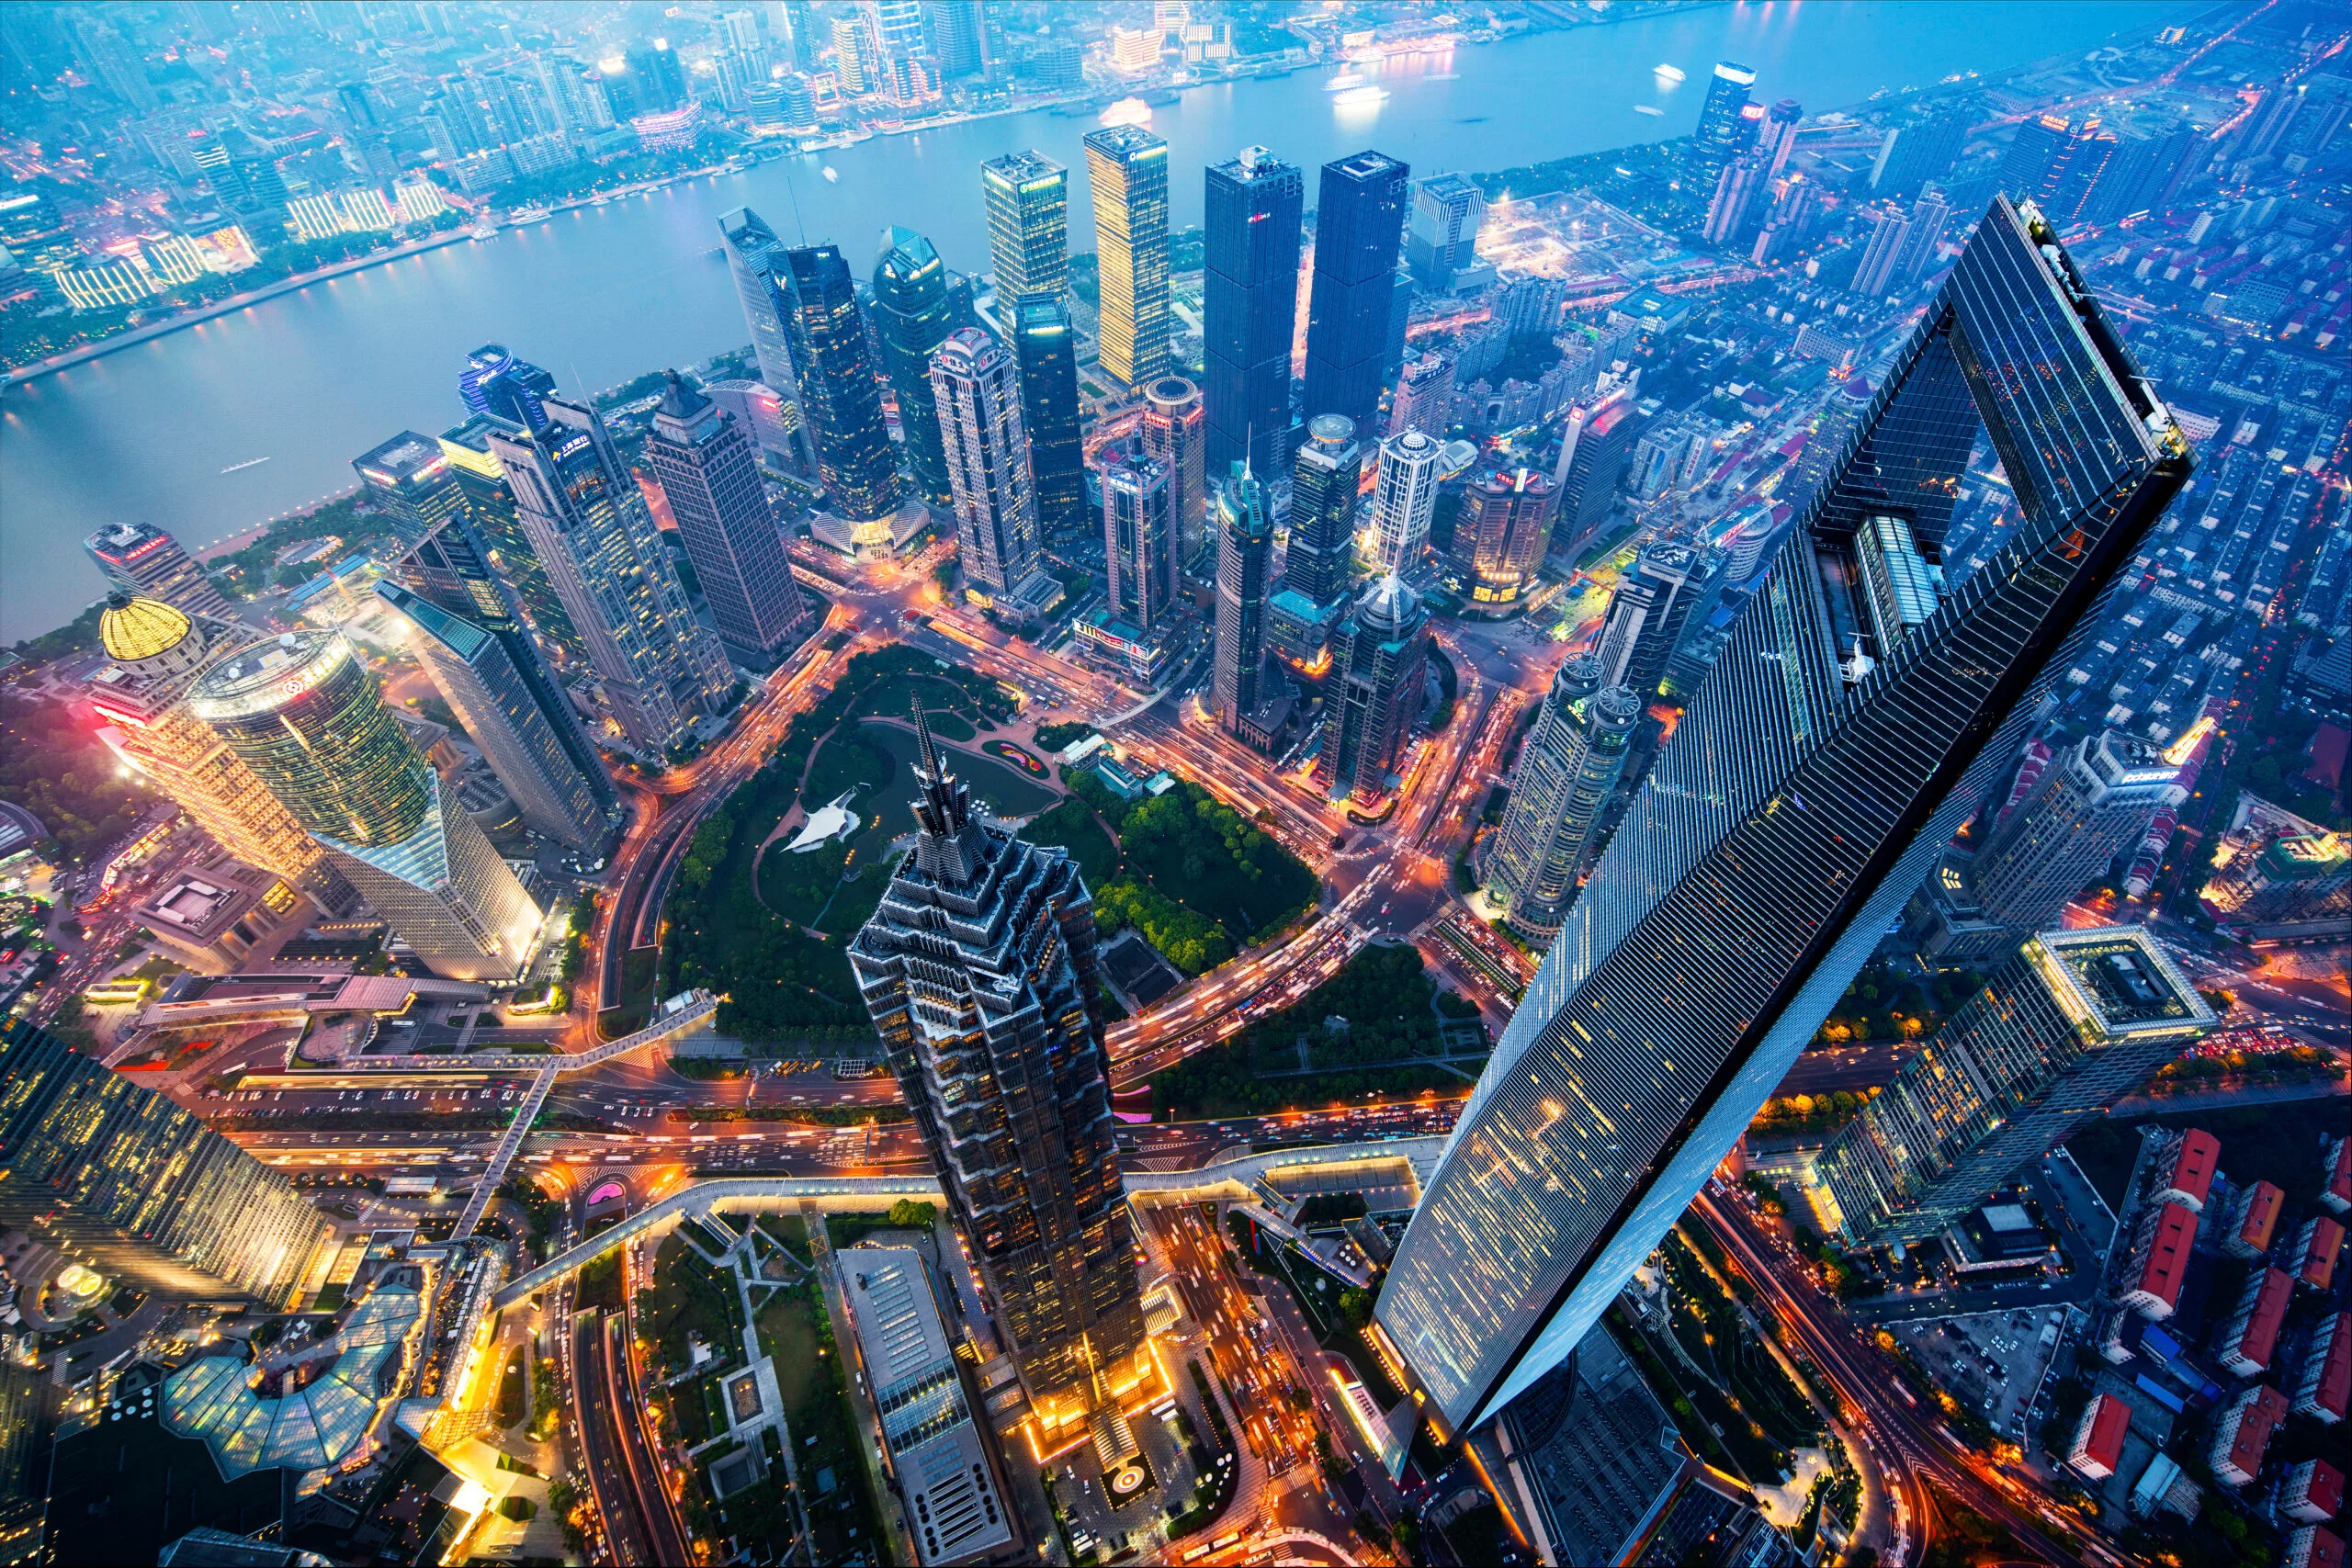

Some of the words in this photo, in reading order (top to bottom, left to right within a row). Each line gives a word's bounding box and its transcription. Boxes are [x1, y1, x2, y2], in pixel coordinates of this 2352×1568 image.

[561, 434, 588, 453] 上海银行
[1496, 472, 1515, 486] CSSC
